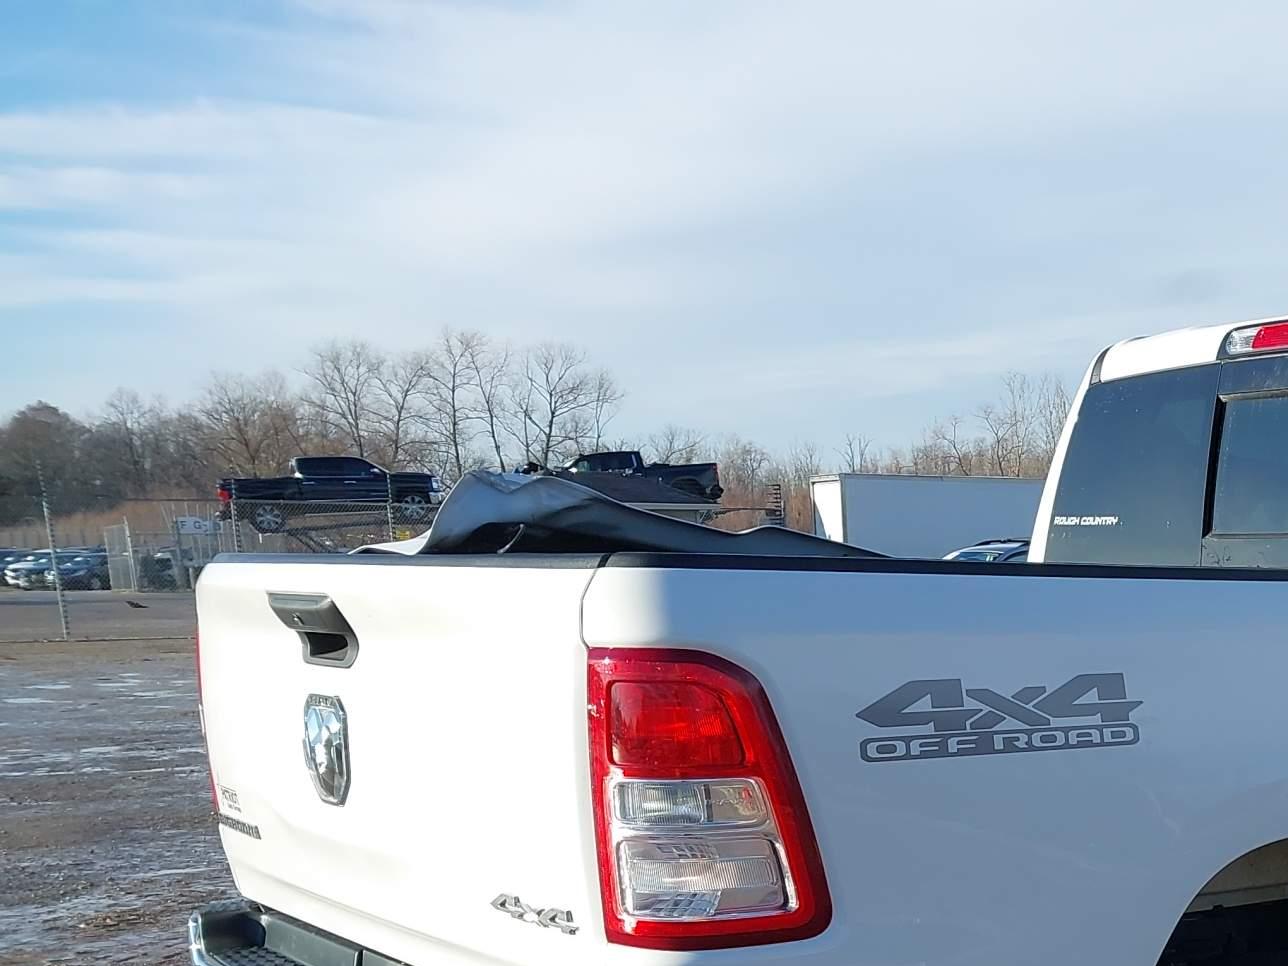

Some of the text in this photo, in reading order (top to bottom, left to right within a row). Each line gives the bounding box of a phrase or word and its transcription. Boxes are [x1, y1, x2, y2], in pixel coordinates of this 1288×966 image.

[1053, 516, 1119, 526] ROUGH COUNTRY
[866, 725, 1135, 759] OFF ROAD
